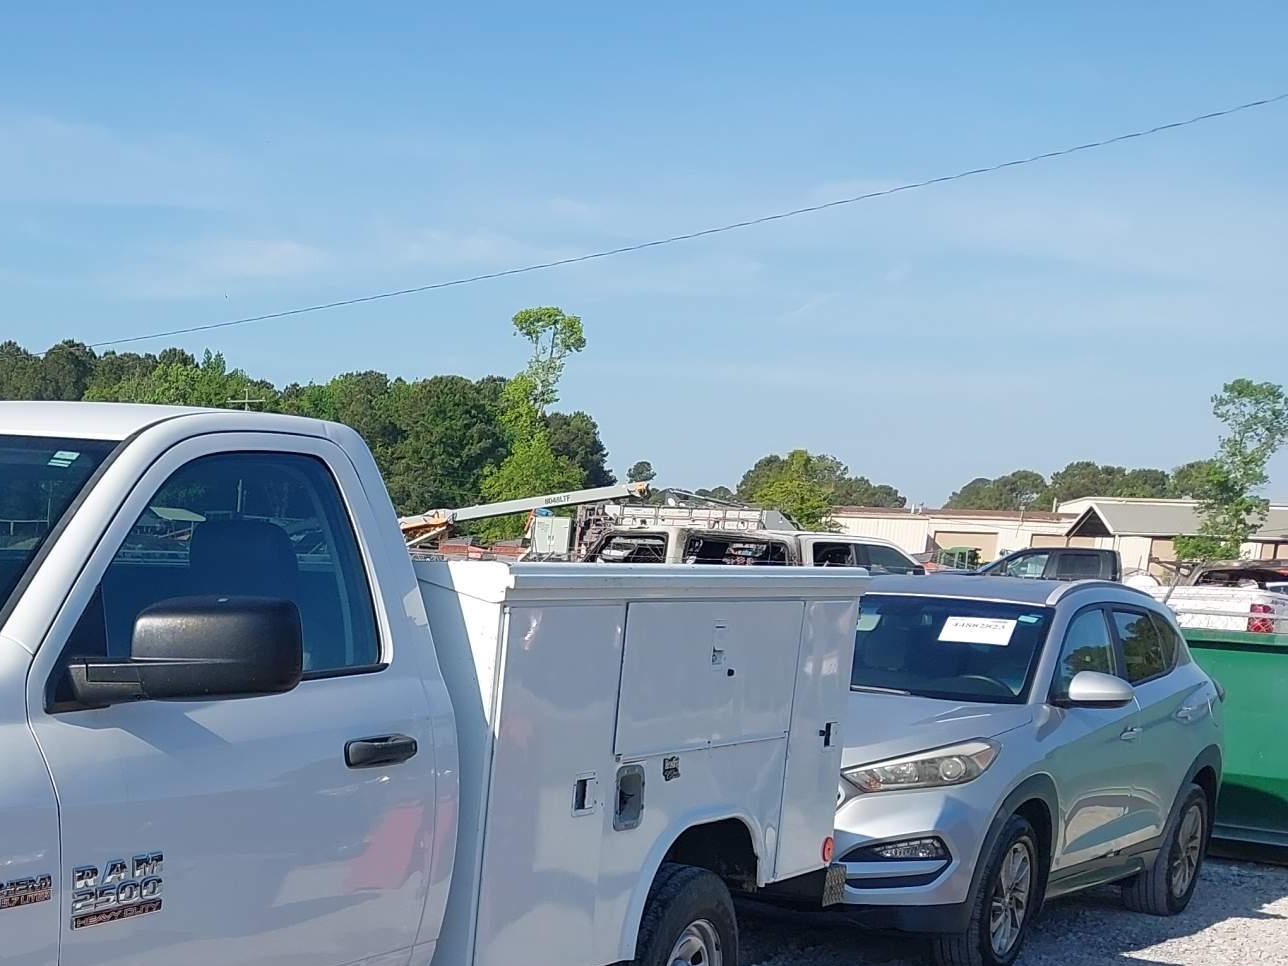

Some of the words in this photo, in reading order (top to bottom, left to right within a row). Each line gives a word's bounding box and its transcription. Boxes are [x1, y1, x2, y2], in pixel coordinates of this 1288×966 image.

[72, 852, 164, 890] RAM
[72, 876, 163, 914] 2500
[75, 909, 122, 929] HEAVY
[122, 901, 161, 919] DUTY
